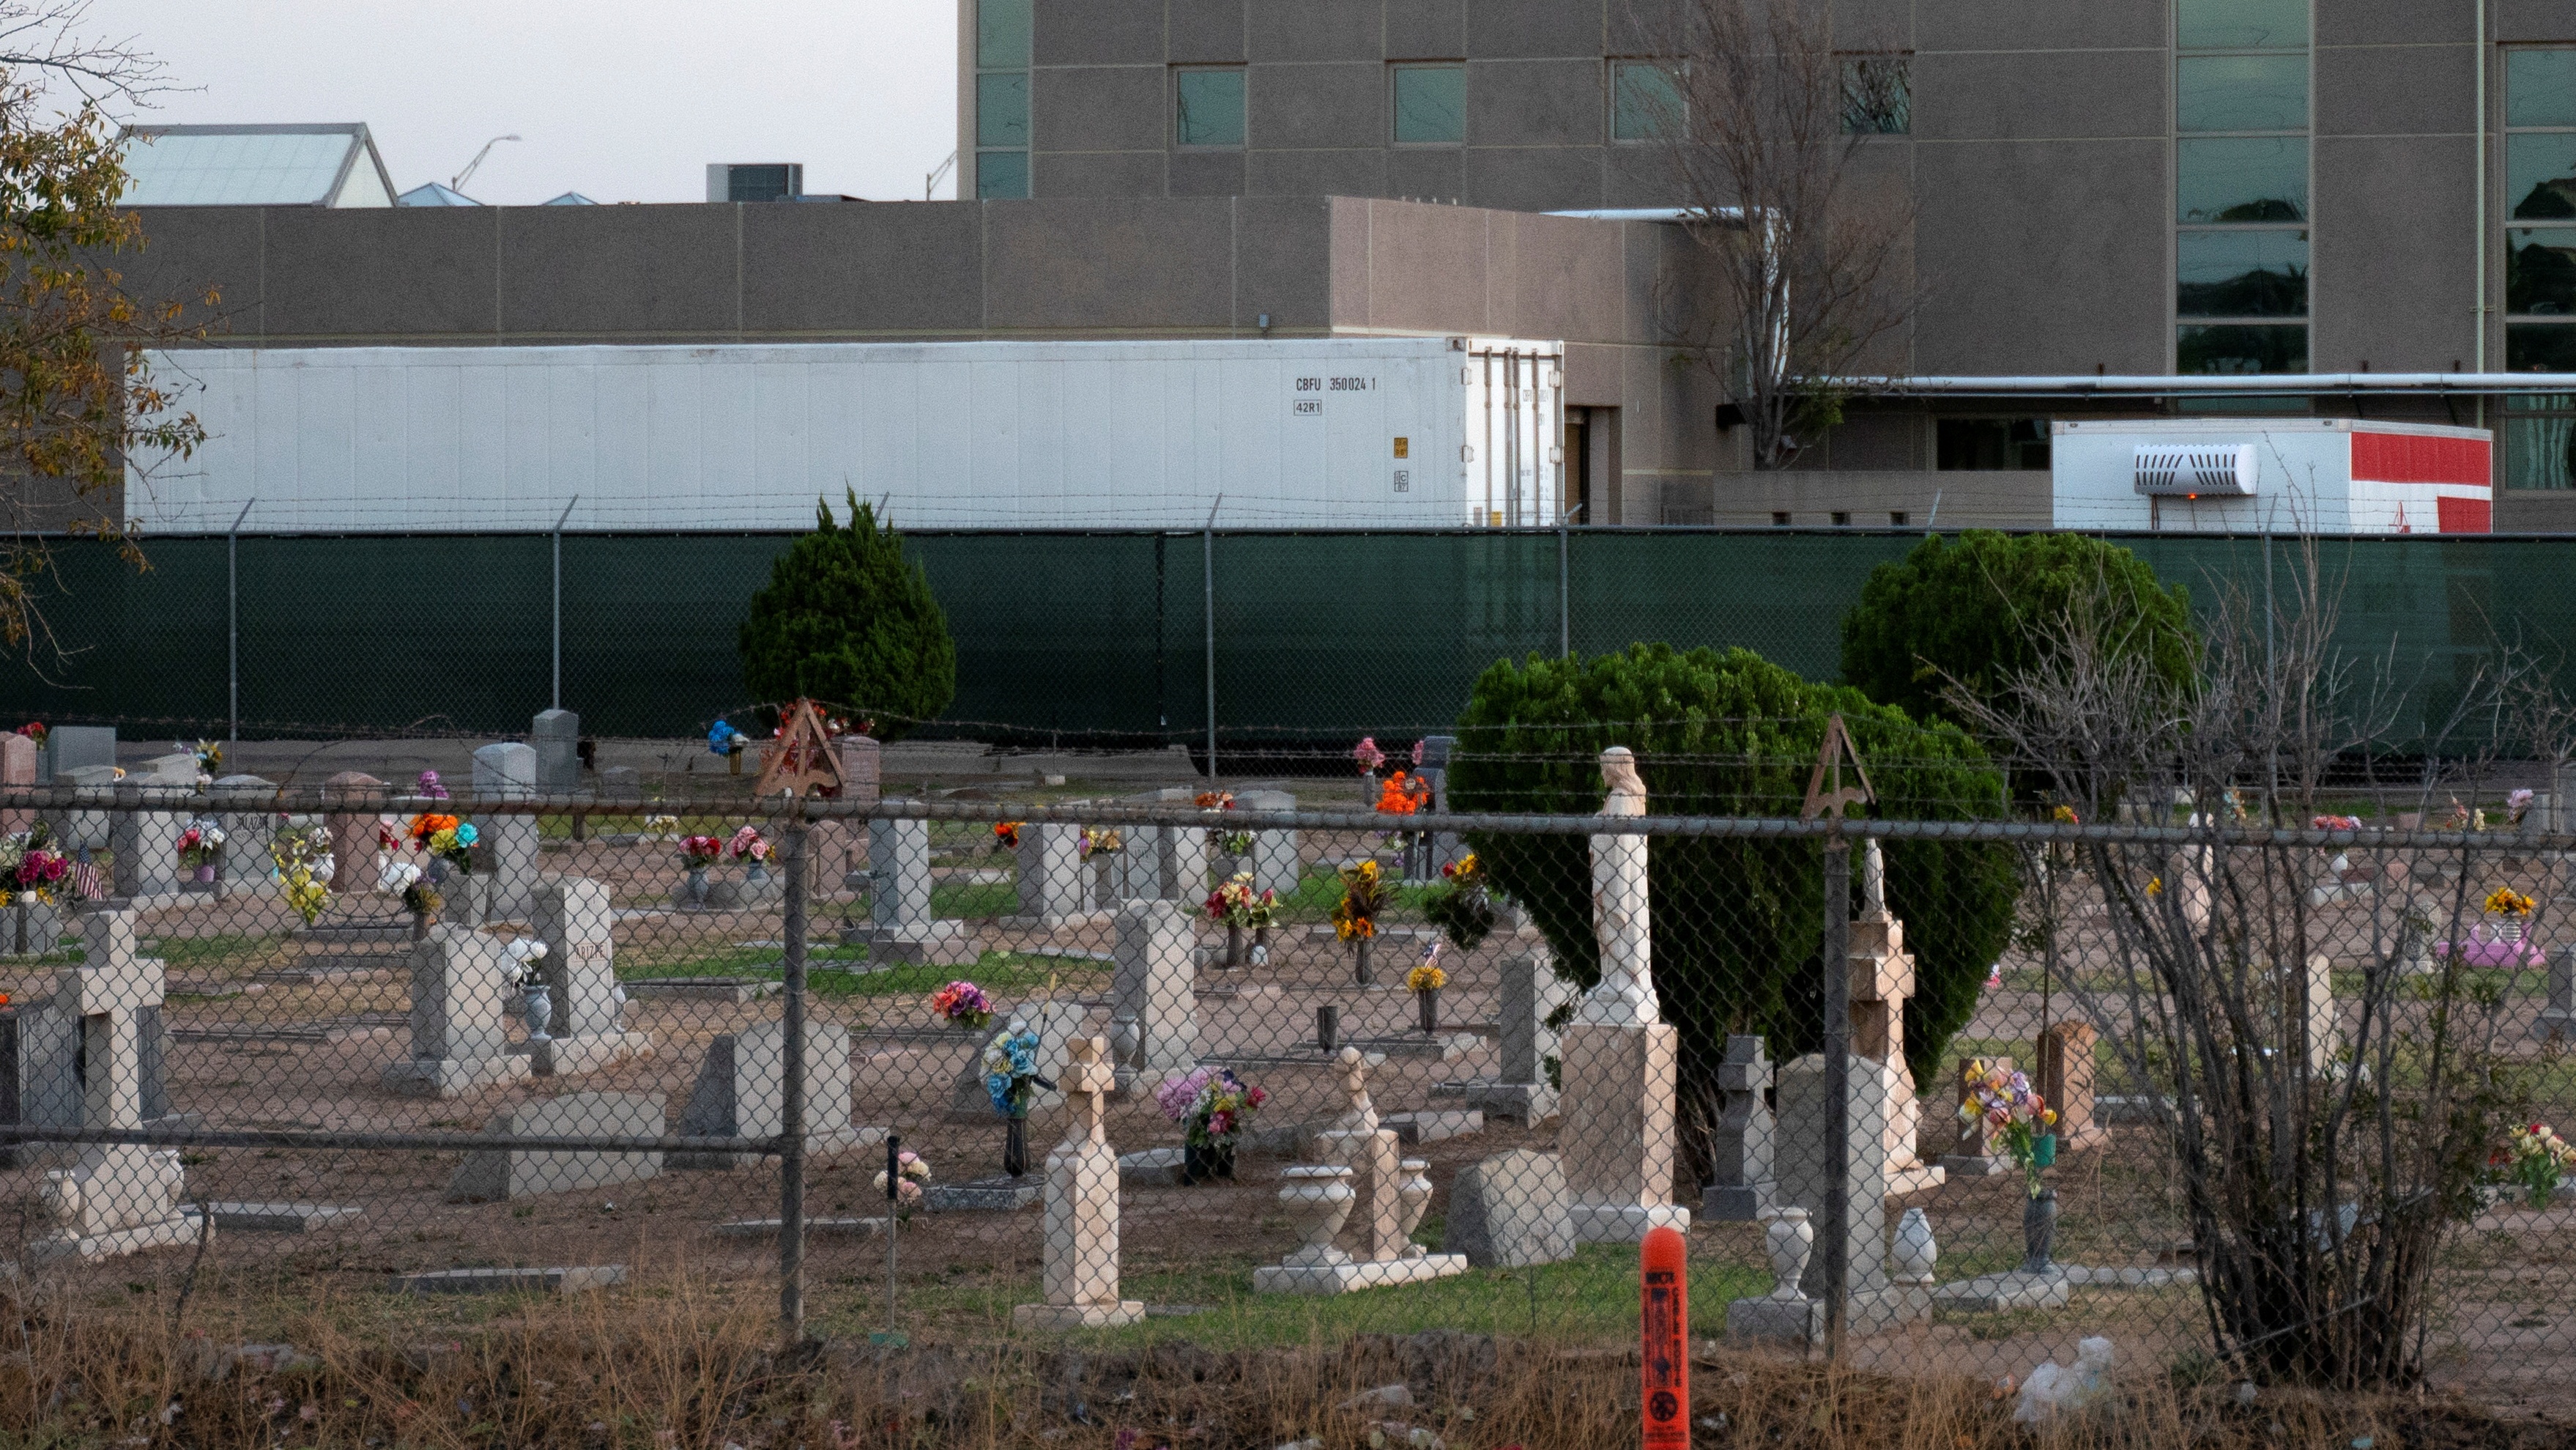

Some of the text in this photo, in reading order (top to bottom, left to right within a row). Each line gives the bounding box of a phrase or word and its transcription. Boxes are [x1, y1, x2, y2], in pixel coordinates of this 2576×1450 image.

[1296, 377, 1376, 391] CBFU 350024 1
[1296, 403, 1320, 413] 42R1
